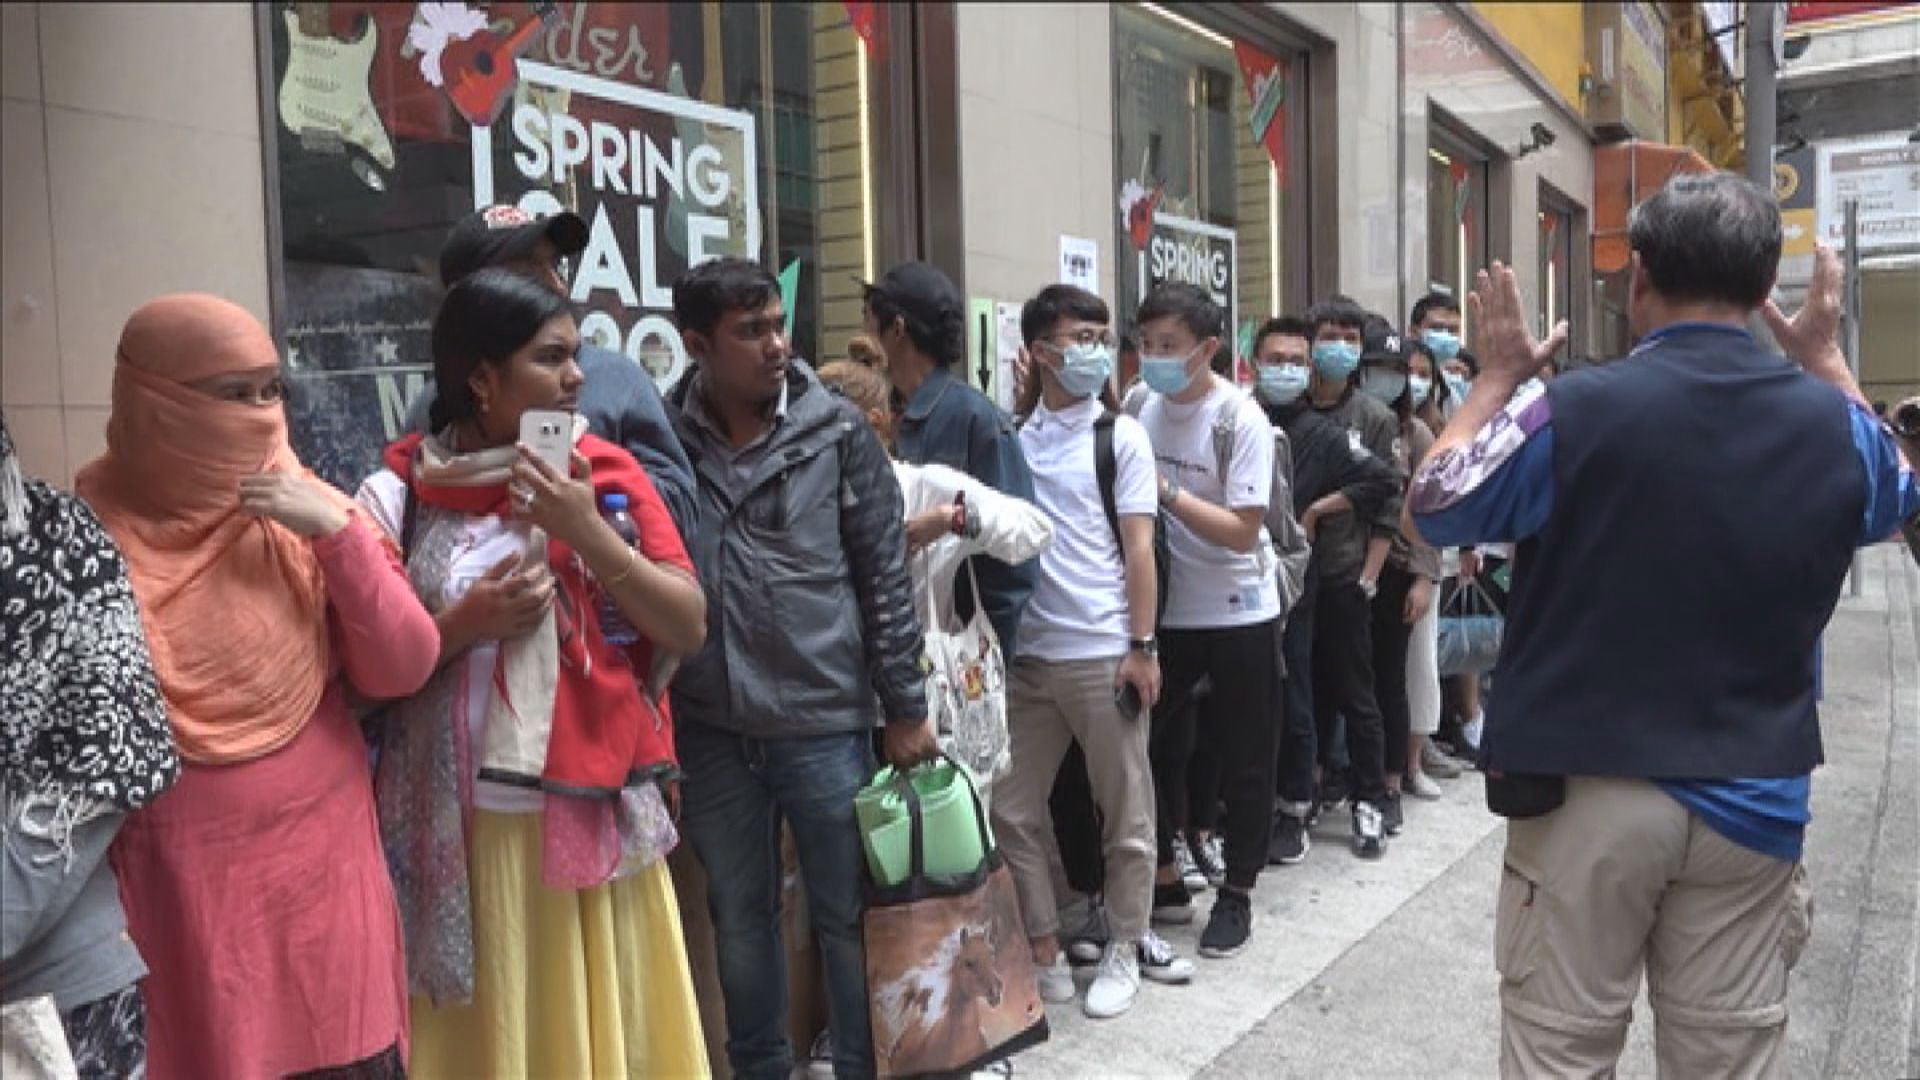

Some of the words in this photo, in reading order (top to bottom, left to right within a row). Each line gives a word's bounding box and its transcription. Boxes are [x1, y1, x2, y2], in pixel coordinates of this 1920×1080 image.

[513, 104, 730, 206] SPRING
[517, 190, 730, 308] ALE
[1151, 234, 1227, 289] SPRING
